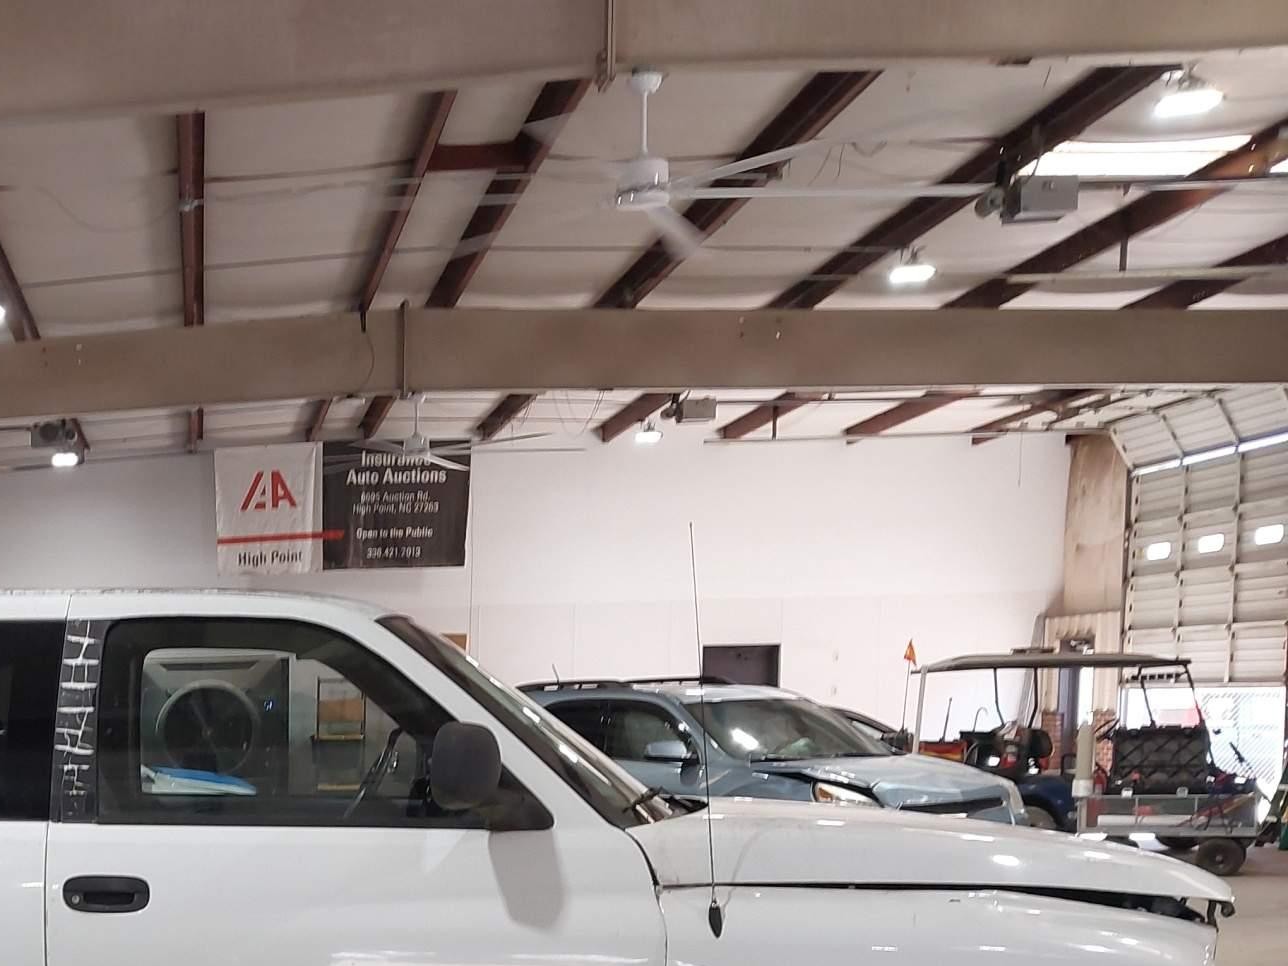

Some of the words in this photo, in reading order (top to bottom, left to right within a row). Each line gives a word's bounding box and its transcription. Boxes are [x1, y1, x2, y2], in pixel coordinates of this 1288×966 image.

[346, 468, 379, 485] Auto
[382, 466, 447, 484] Auctions
[382, 490, 415, 503] Auction
[352, 503, 372, 516] High
[356, 527, 378, 541] Open
[379, 528, 389, 539] to
[390, 527, 403, 539] the
[405, 525, 433, 539] Public
[238, 550, 267, 568] High
[271, 548, 303, 564] Point
